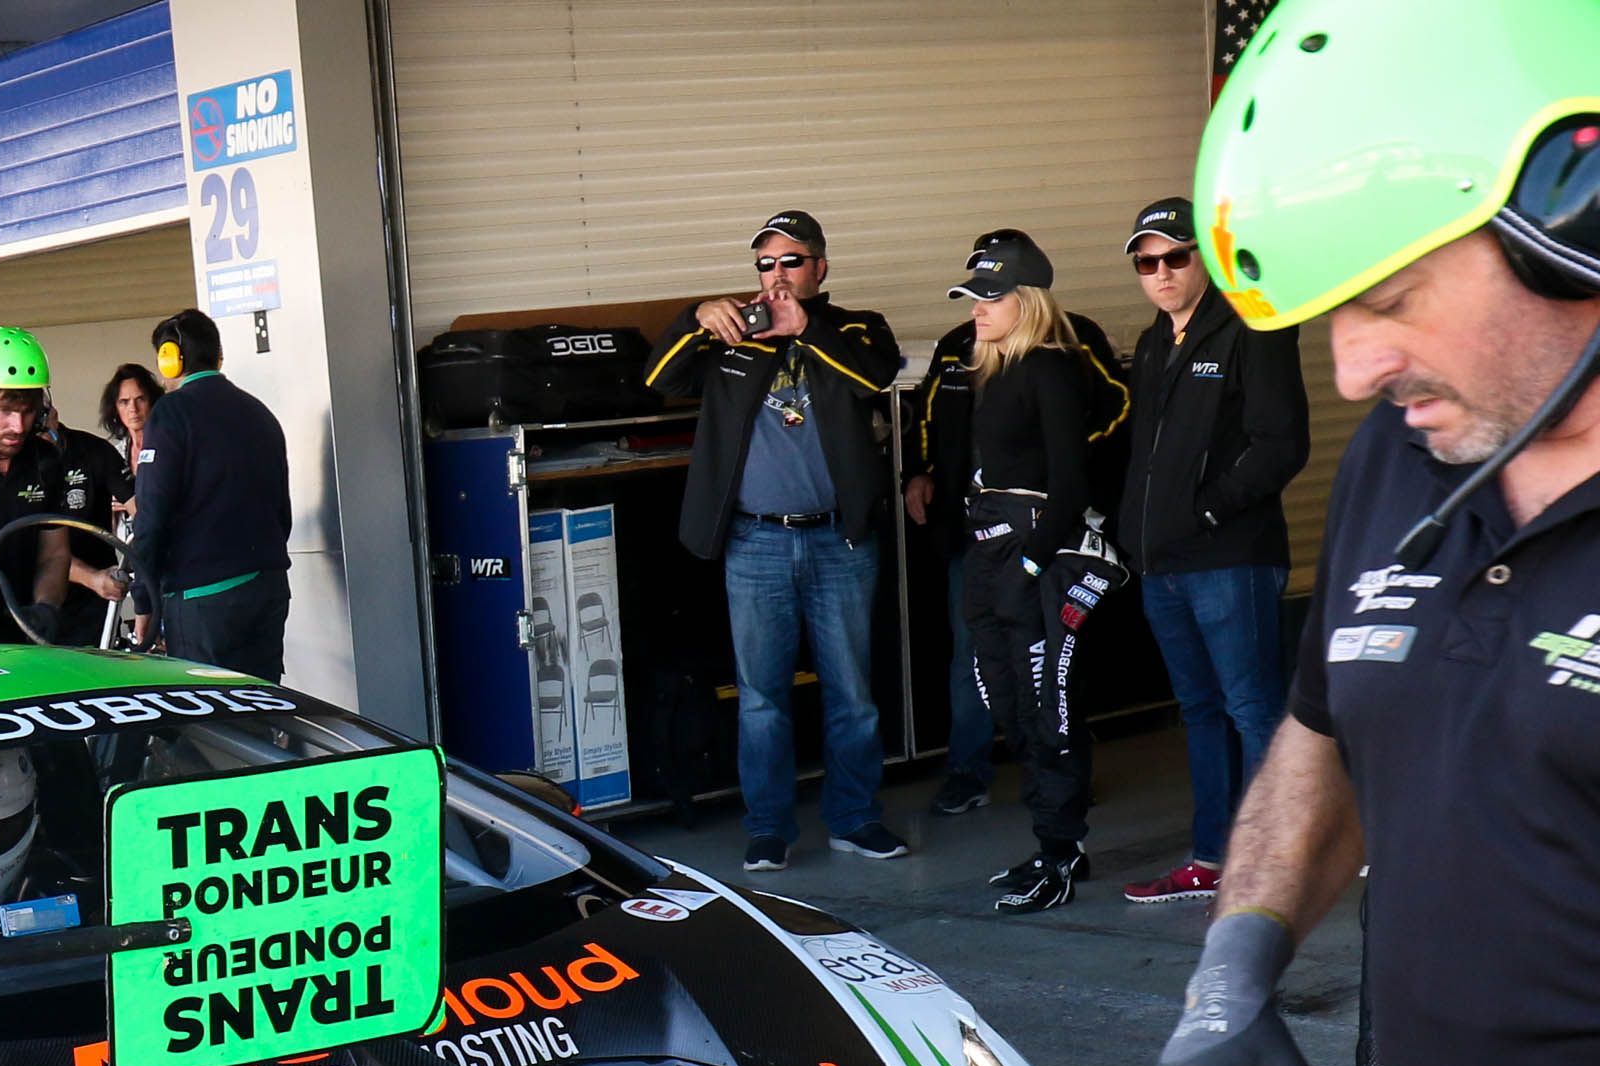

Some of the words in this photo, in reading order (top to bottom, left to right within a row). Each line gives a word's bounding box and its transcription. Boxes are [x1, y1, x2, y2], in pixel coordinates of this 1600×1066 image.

[236, 78, 278, 120] NO
[226, 111, 294, 158] SMOKING
[201, 167, 259, 264] 29
[1192, 362, 1220, 375] WTR
[471, 558, 504, 577] WTR
[1057, 634, 1076, 687] DUBUIS
[1058, 689, 1069, 736] ROGER
[157, 786, 393, 869] TRANS
[161, 851, 392, 920] PONDEUR
[163, 915, 392, 985] PONDEUR
[163, 964, 395, 1053] TRANS
[442, 943, 640, 1037] loud
